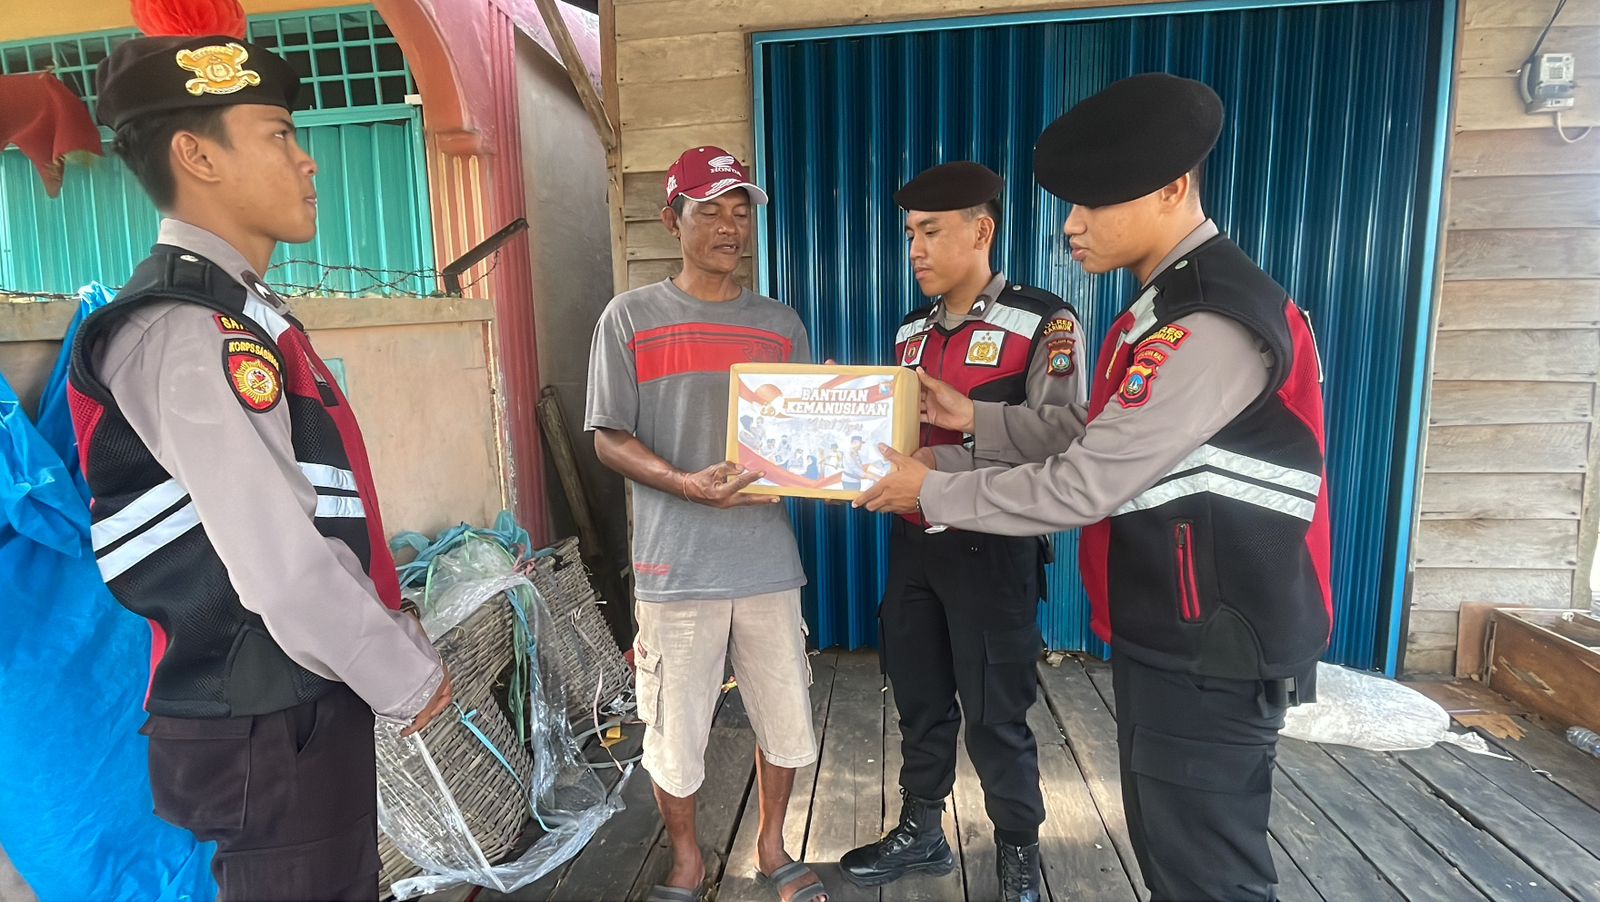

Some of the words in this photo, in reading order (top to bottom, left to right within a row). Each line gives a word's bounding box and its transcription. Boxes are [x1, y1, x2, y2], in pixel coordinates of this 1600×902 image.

[710, 166, 742, 177] HONDA
[229, 341, 255, 353] KORPS
[802, 387, 869, 402] BANTUAN
[785, 401, 889, 416] KEMANUSIAAN
